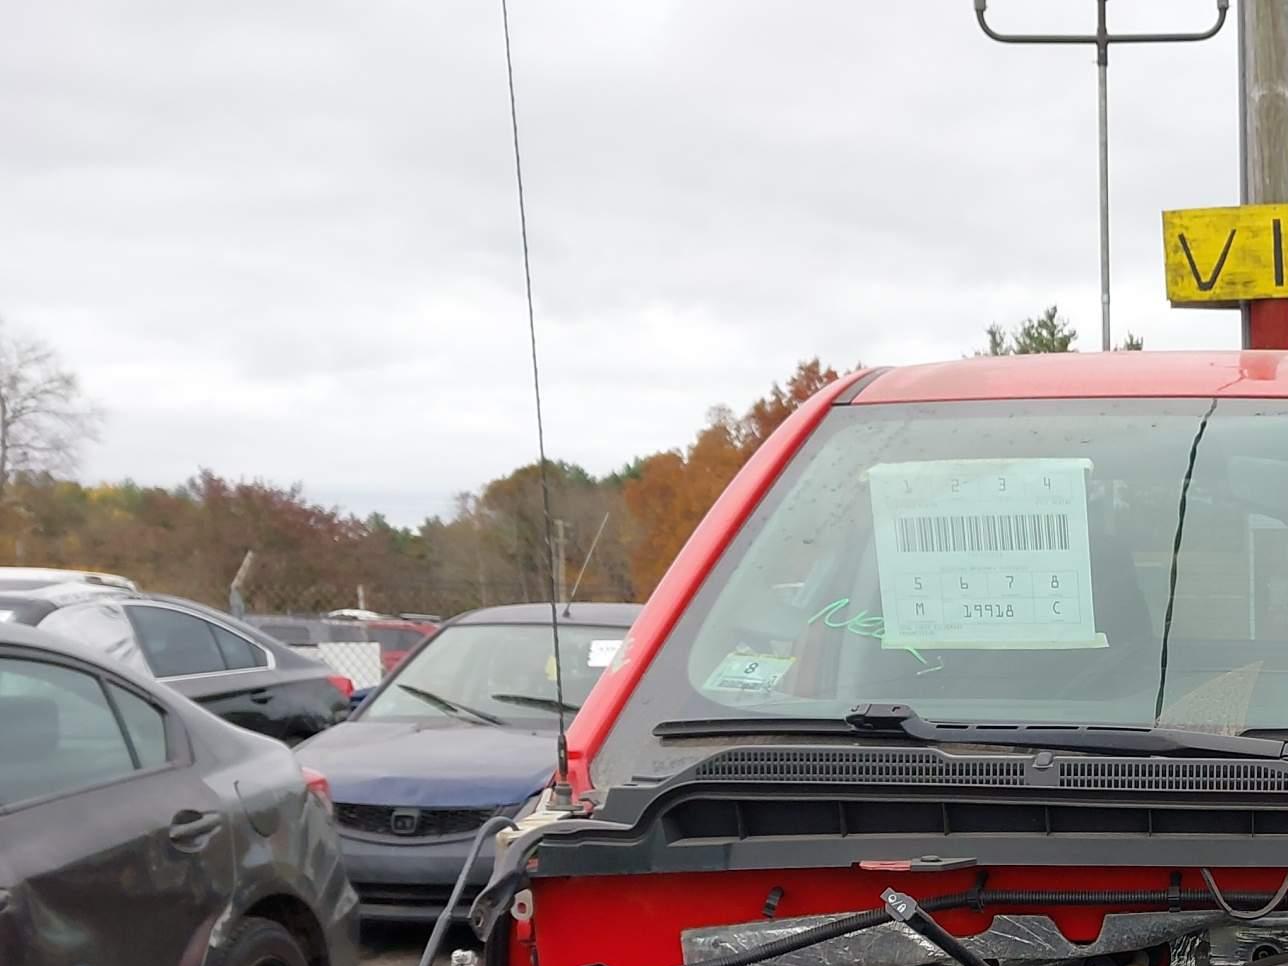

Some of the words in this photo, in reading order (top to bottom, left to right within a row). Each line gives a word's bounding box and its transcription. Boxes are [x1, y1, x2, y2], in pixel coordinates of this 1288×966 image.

[951, 478, 960, 493] 2
[998, 478, 1006, 492] 3
[1042, 476, 1051, 489] 4
[914, 576, 923, 590] 5
[959, 576, 969, 590] 6
[1005, 575, 1014, 589] 7
[1050, 575, 1060, 589] 8
[915, 602, 925, 616] M
[1052, 601, 1061, 615] C
